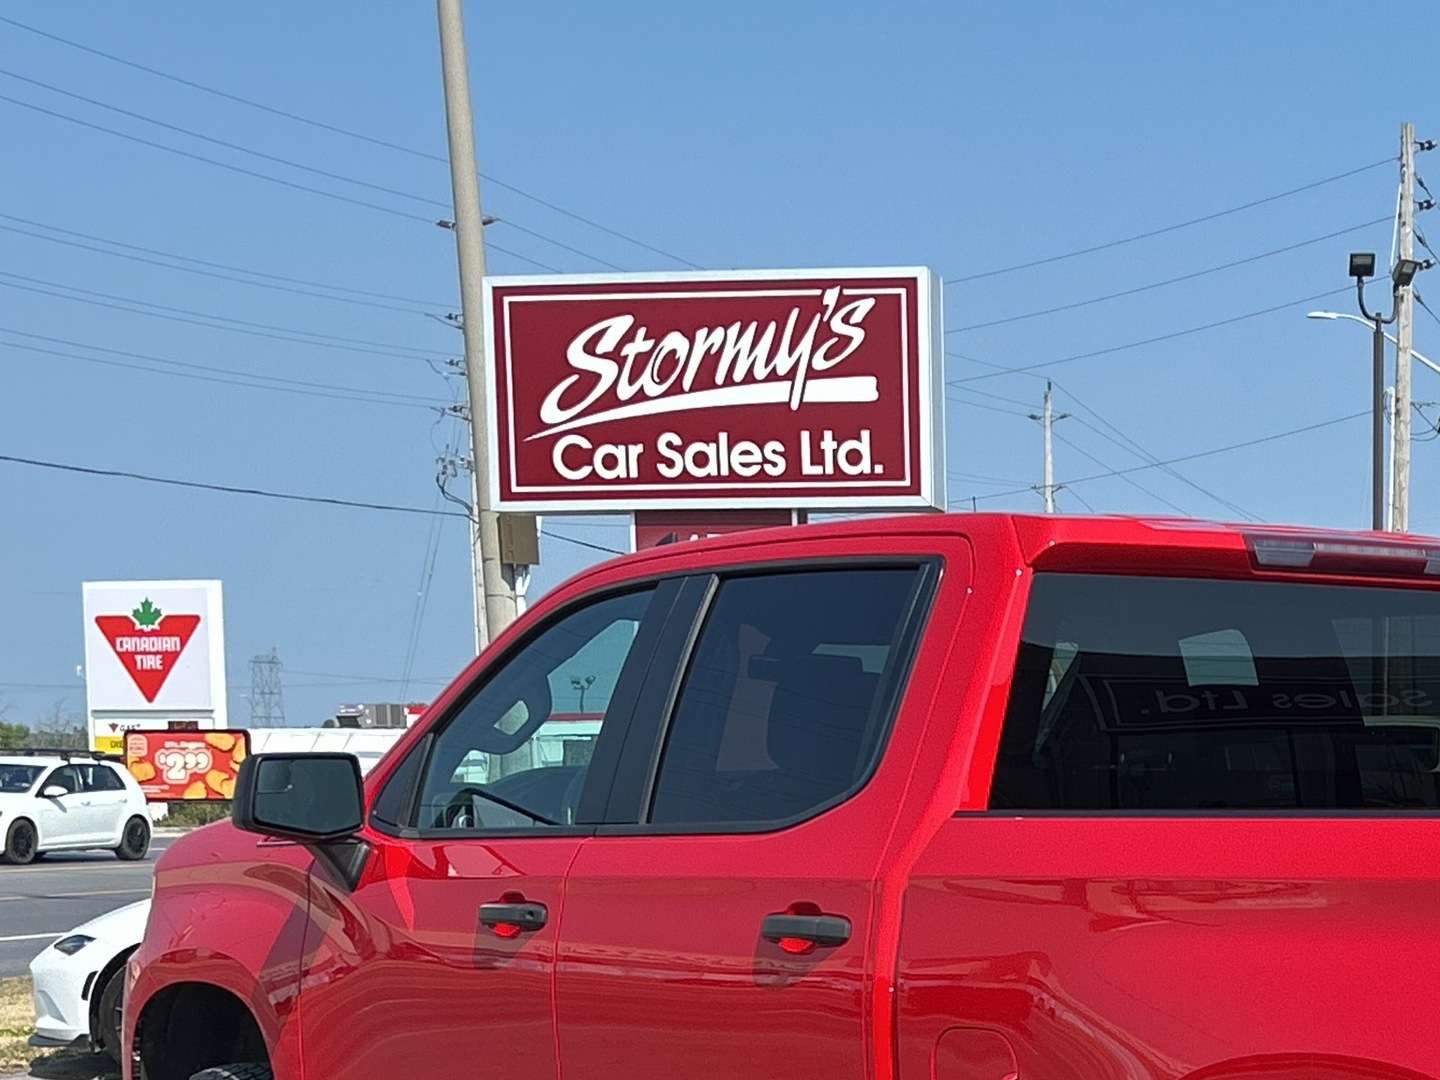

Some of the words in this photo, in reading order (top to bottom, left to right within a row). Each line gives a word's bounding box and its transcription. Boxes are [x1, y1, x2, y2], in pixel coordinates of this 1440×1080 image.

[538, 286, 876, 424] Stormy's
[552, 433, 643, 481] Car
[656, 431, 787, 479] Sales
[801, 429, 884, 477] Ltd.
[115, 636, 181, 652] CANADIAN
[134, 654, 163, 670] TIRE
